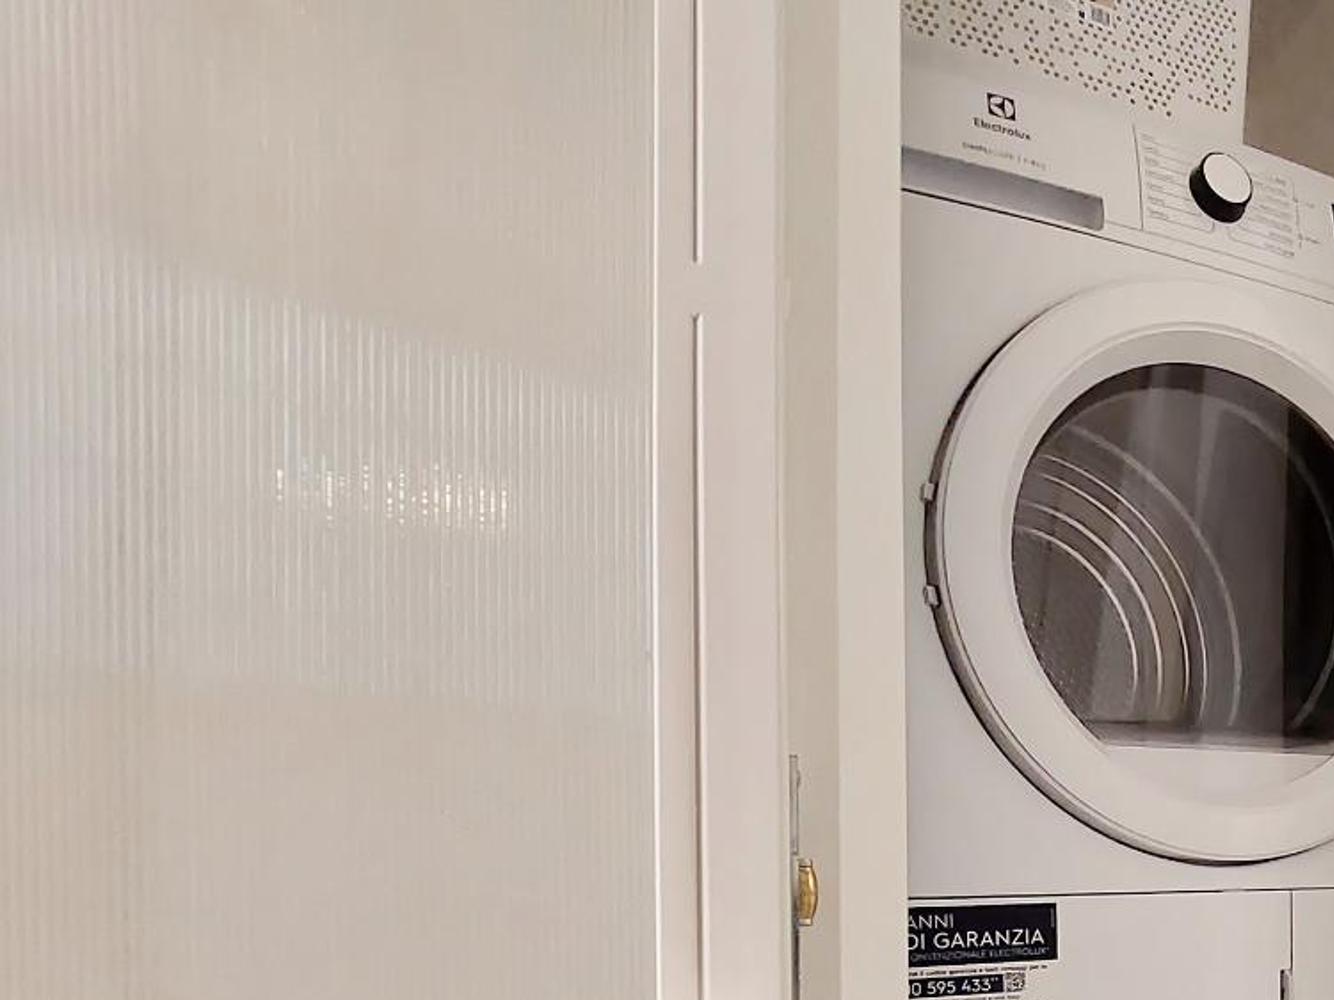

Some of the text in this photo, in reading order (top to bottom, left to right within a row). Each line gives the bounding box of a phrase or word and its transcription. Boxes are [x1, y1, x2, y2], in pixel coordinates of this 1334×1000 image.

[908, 913, 954, 930] ANNI
[908, 928, 1045, 950] DI GARANZIA
[926, 980, 957, 995] 595
